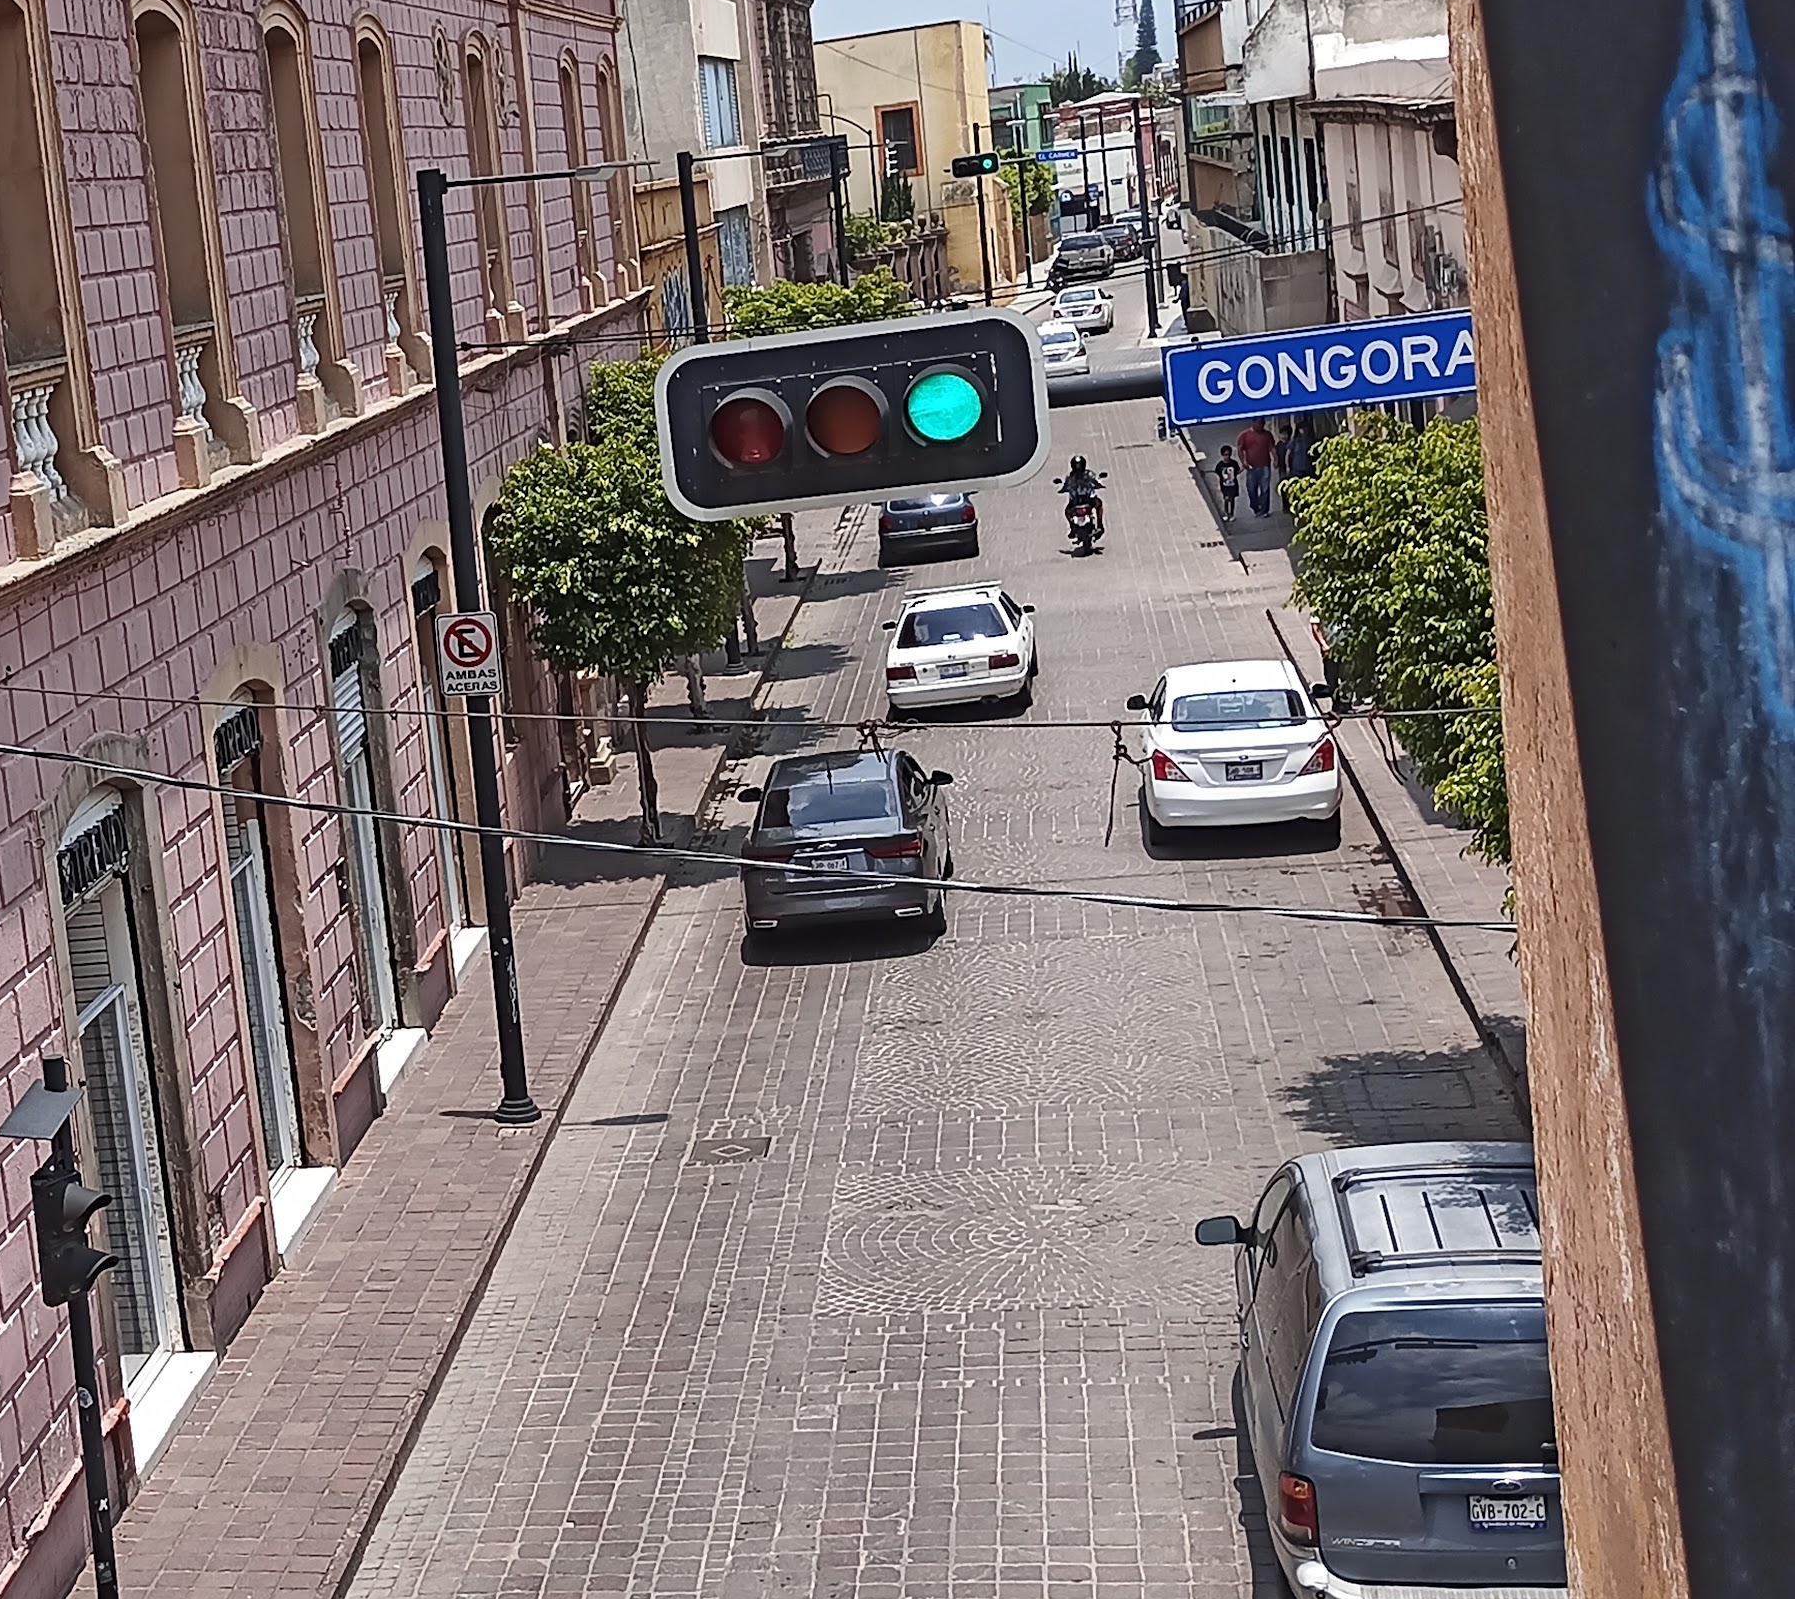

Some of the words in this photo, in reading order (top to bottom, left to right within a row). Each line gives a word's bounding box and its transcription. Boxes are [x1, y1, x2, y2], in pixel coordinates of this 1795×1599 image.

[1048, 151, 1076, 159] CARMEN
[1197, 328, 1475, 404] GONGORA
[445, 668, 497, 681] AMBAS
[446, 681, 498, 693] ACERAS
[1471, 1502, 1544, 1519] GVB-702-C
